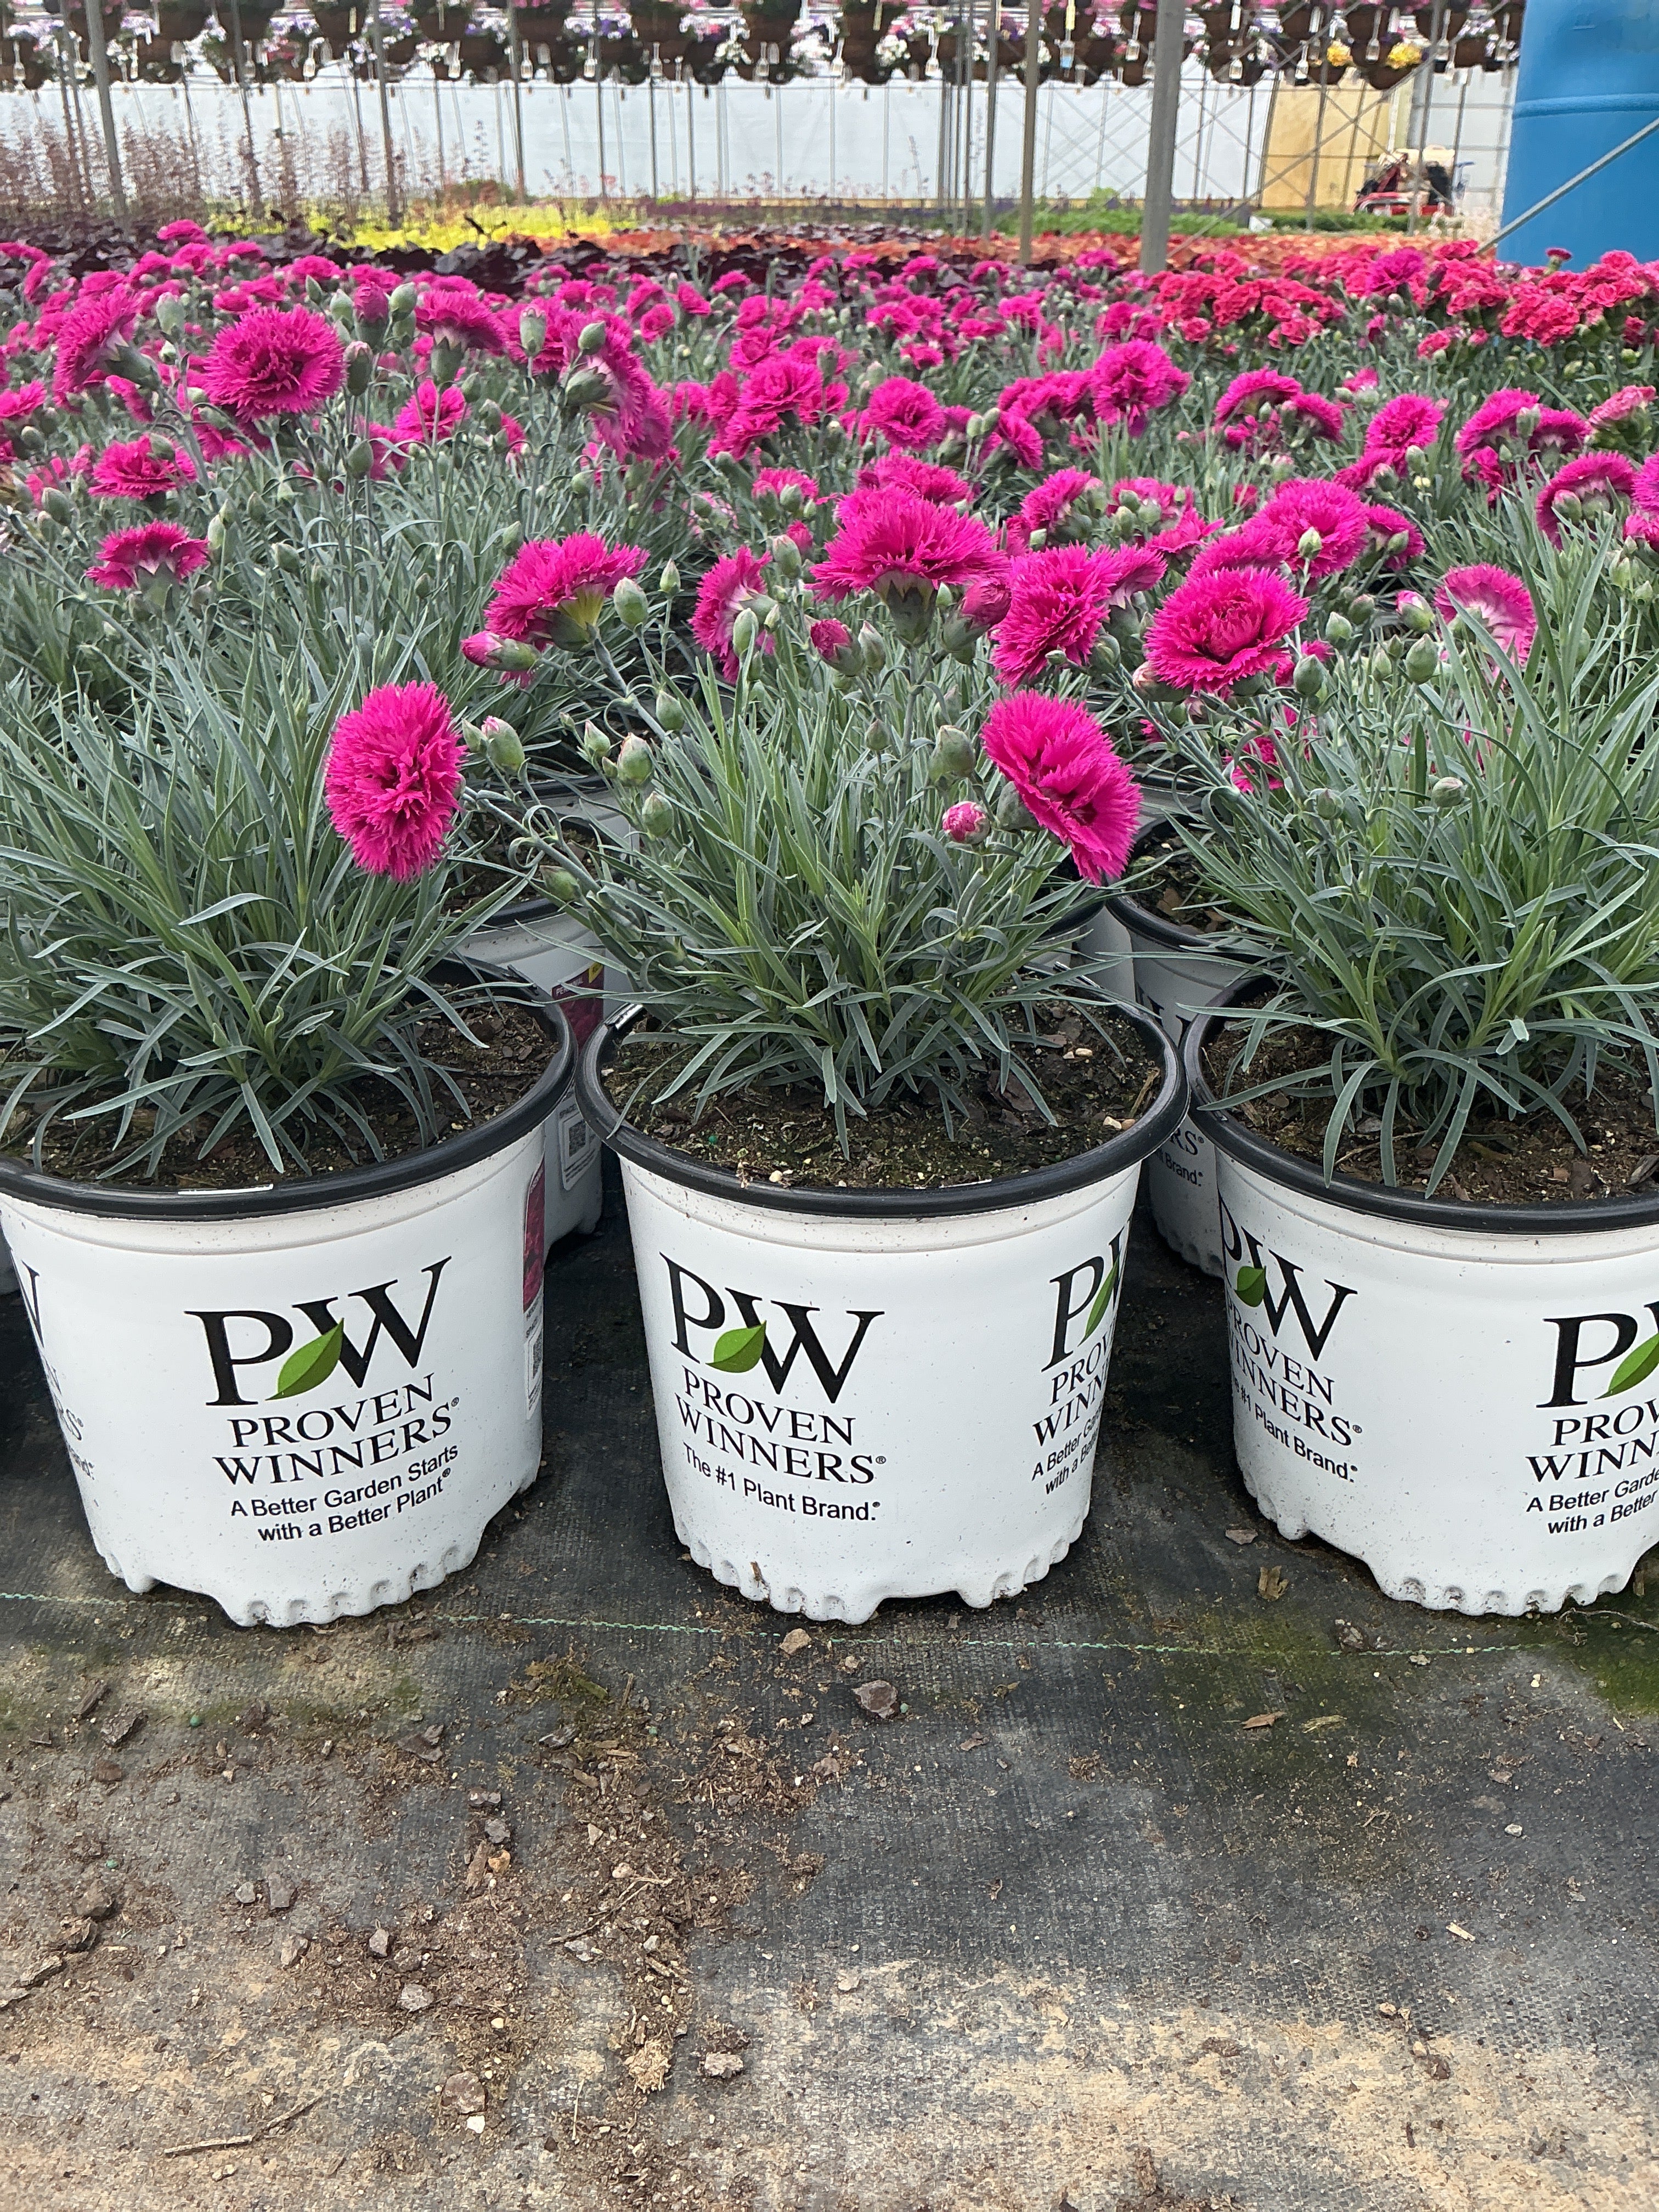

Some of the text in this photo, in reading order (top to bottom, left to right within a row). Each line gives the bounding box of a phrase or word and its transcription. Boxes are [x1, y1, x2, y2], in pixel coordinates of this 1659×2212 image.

[184, 1256, 452, 1406] PW
[660, 1252, 884, 1403] PW
[1536, 1301, 1659, 1408] P
[227, 1373, 435, 1448] PROVEN
[675, 1392, 887, 1485] WINNERS®
[682, 1365, 856, 1446] PROVEN
[1255, 1403, 1290, 1448] Plant
[212, 1397, 460, 1486] WINNERS®
[684, 1442, 711, 1477] The
[716, 1465, 736, 1491] #1
[744, 1478, 796, 1512] Plant
[1031, 1462, 1043, 1481] A
[1047, 1432, 1081, 1472] Better
[1045, 1466, 1069, 1495] with
[1071, 1458, 1078, 1474] a
[1525, 1431, 1659, 1482] WINN
[231, 1444, 459, 1516] A Better Garden Starts
[1526, 1497, 1543, 1513] A
[1549, 1489, 1610, 1511] Better
[1548, 1489, 1657, 1534] with a Better
[258, 1523, 304, 1541] with
[308, 1523, 323, 1537] a
[329, 1503, 391, 1533] Better
